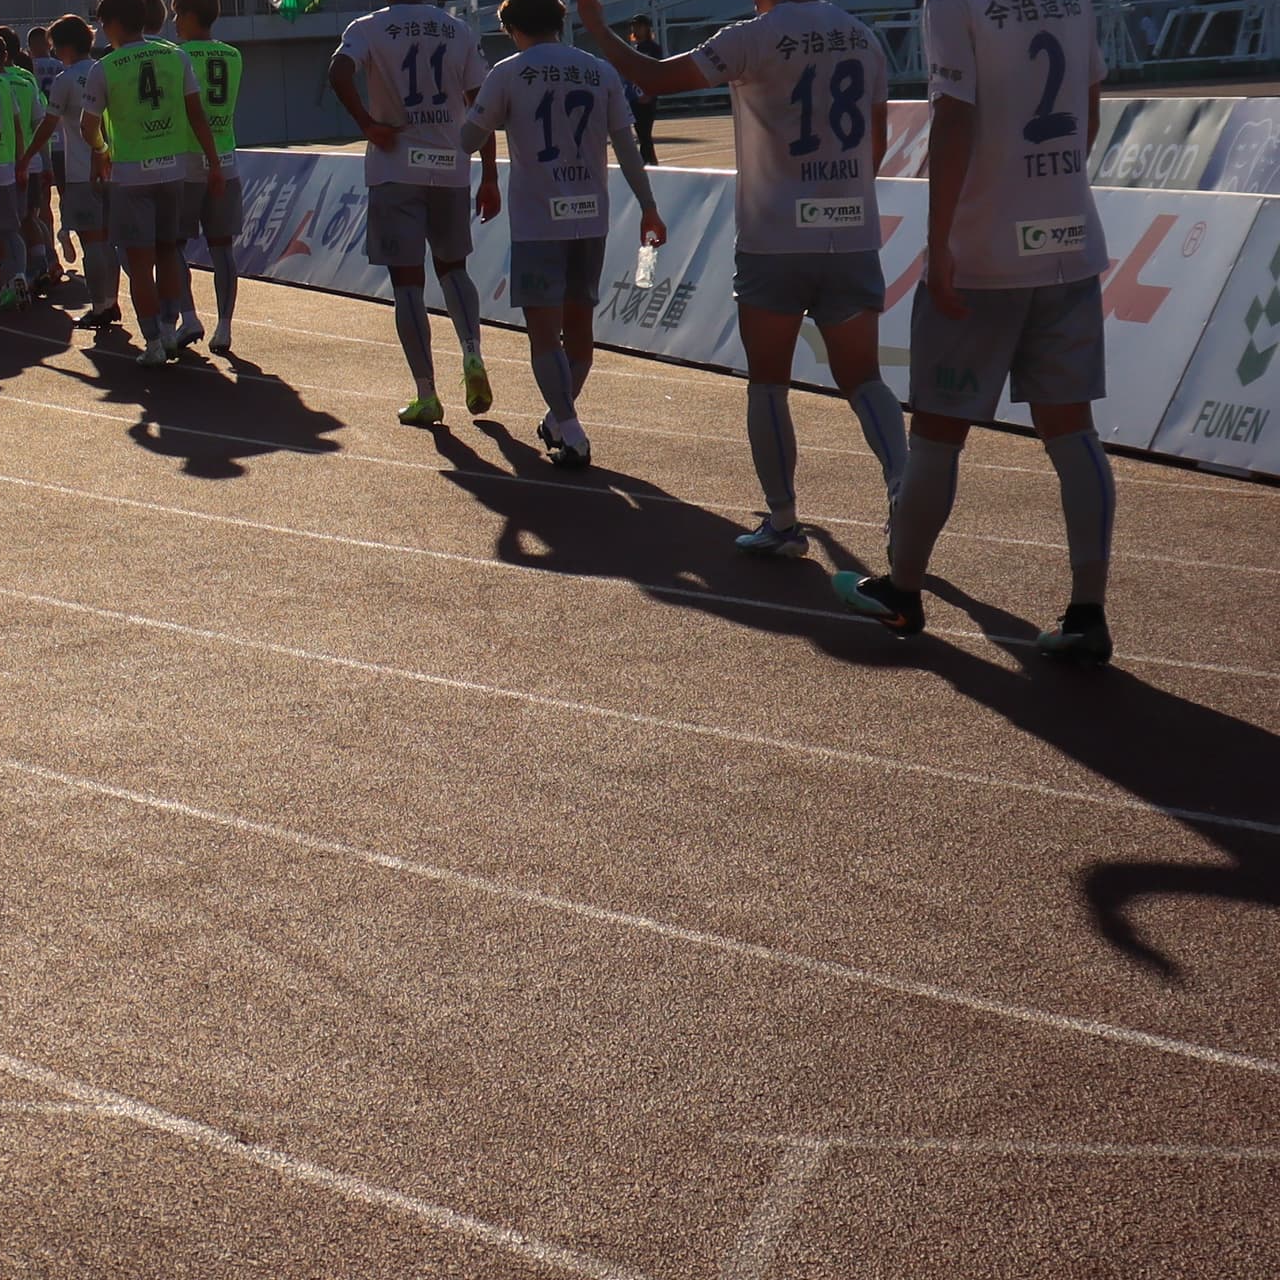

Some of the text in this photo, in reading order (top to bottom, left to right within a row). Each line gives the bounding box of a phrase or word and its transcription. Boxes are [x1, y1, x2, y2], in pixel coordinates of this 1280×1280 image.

[385, 22, 456, 39] 今治造船
[776, 26, 869, 60] 今治造船
[140, 59, 164, 111] 4
[206, 57, 228, 107] 9
[402, 41, 448, 107] 11
[519, 64, 601, 87] 今治造船
[1023, 29, 1079, 145] 2
[535, 89, 594, 163] 17
[788, 58, 866, 156] 18
[552, 166, 591, 182] KYOTA
[800, 159, 859, 183] HIKARU
[1023, 150, 1082, 178] TETSU
[1099, 142, 1200, 189] design
[823, 205, 861, 220] xymax
[1050, 224, 1085, 245] xyma
[1191, 399, 1271, 444] FUNEN
